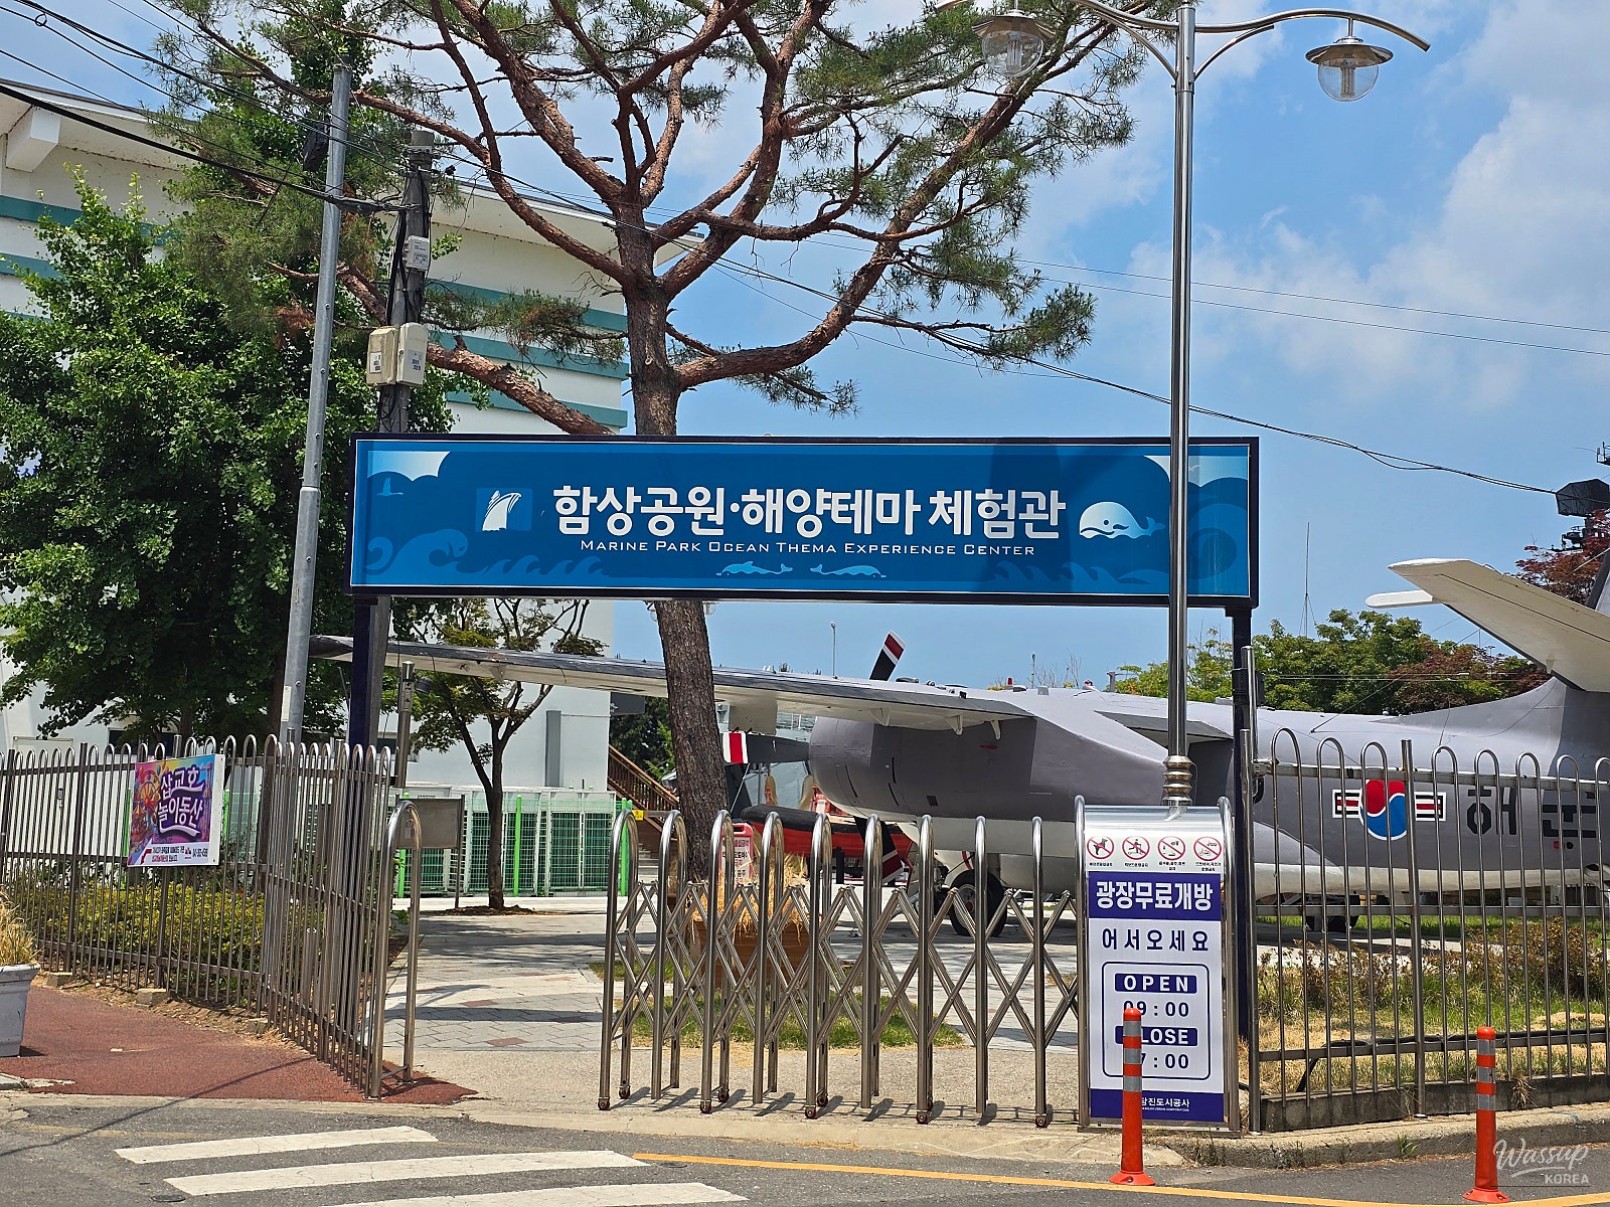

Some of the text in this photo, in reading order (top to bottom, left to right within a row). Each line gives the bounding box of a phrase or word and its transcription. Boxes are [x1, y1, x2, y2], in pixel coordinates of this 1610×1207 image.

[928, 488, 1067, 539] 체험관
[581, 540, 1035, 555] MARINE PARK OCEAN THEMA EXPERIENCE CENTER
[161, 766, 204, 800] 삽교호
[158, 797, 203, 830] 놀이동산
[1096, 881, 1213, 911] 광장무료개방
[1102, 928, 1209, 951] 어서오세요
[1123, 975, 1189, 993] OPEN
[1141, 1028, 1189, 1045] LOSE
[1141, 1052, 1189, 1069] 7:00
